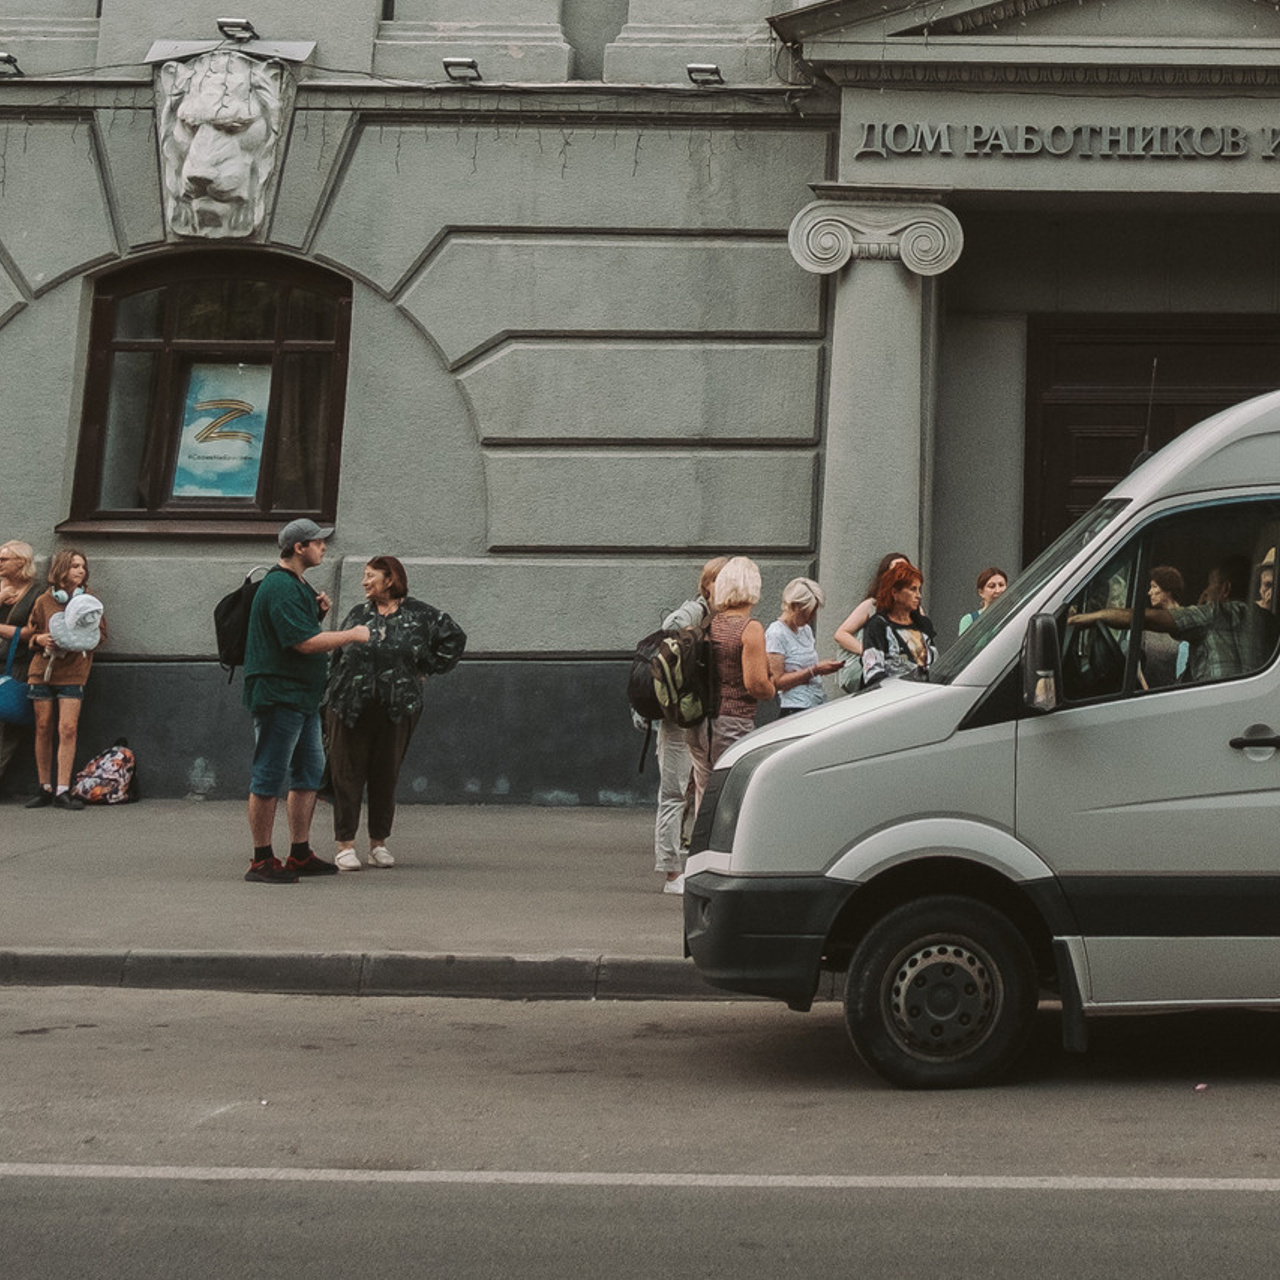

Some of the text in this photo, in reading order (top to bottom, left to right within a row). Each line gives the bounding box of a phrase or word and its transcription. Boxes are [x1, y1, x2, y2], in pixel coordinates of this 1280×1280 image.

[853, 122, 954, 158] ДОМ
[963, 123, 1249, 159] РАБОТНИКОВ
[194, 399, 256, 444] Z
